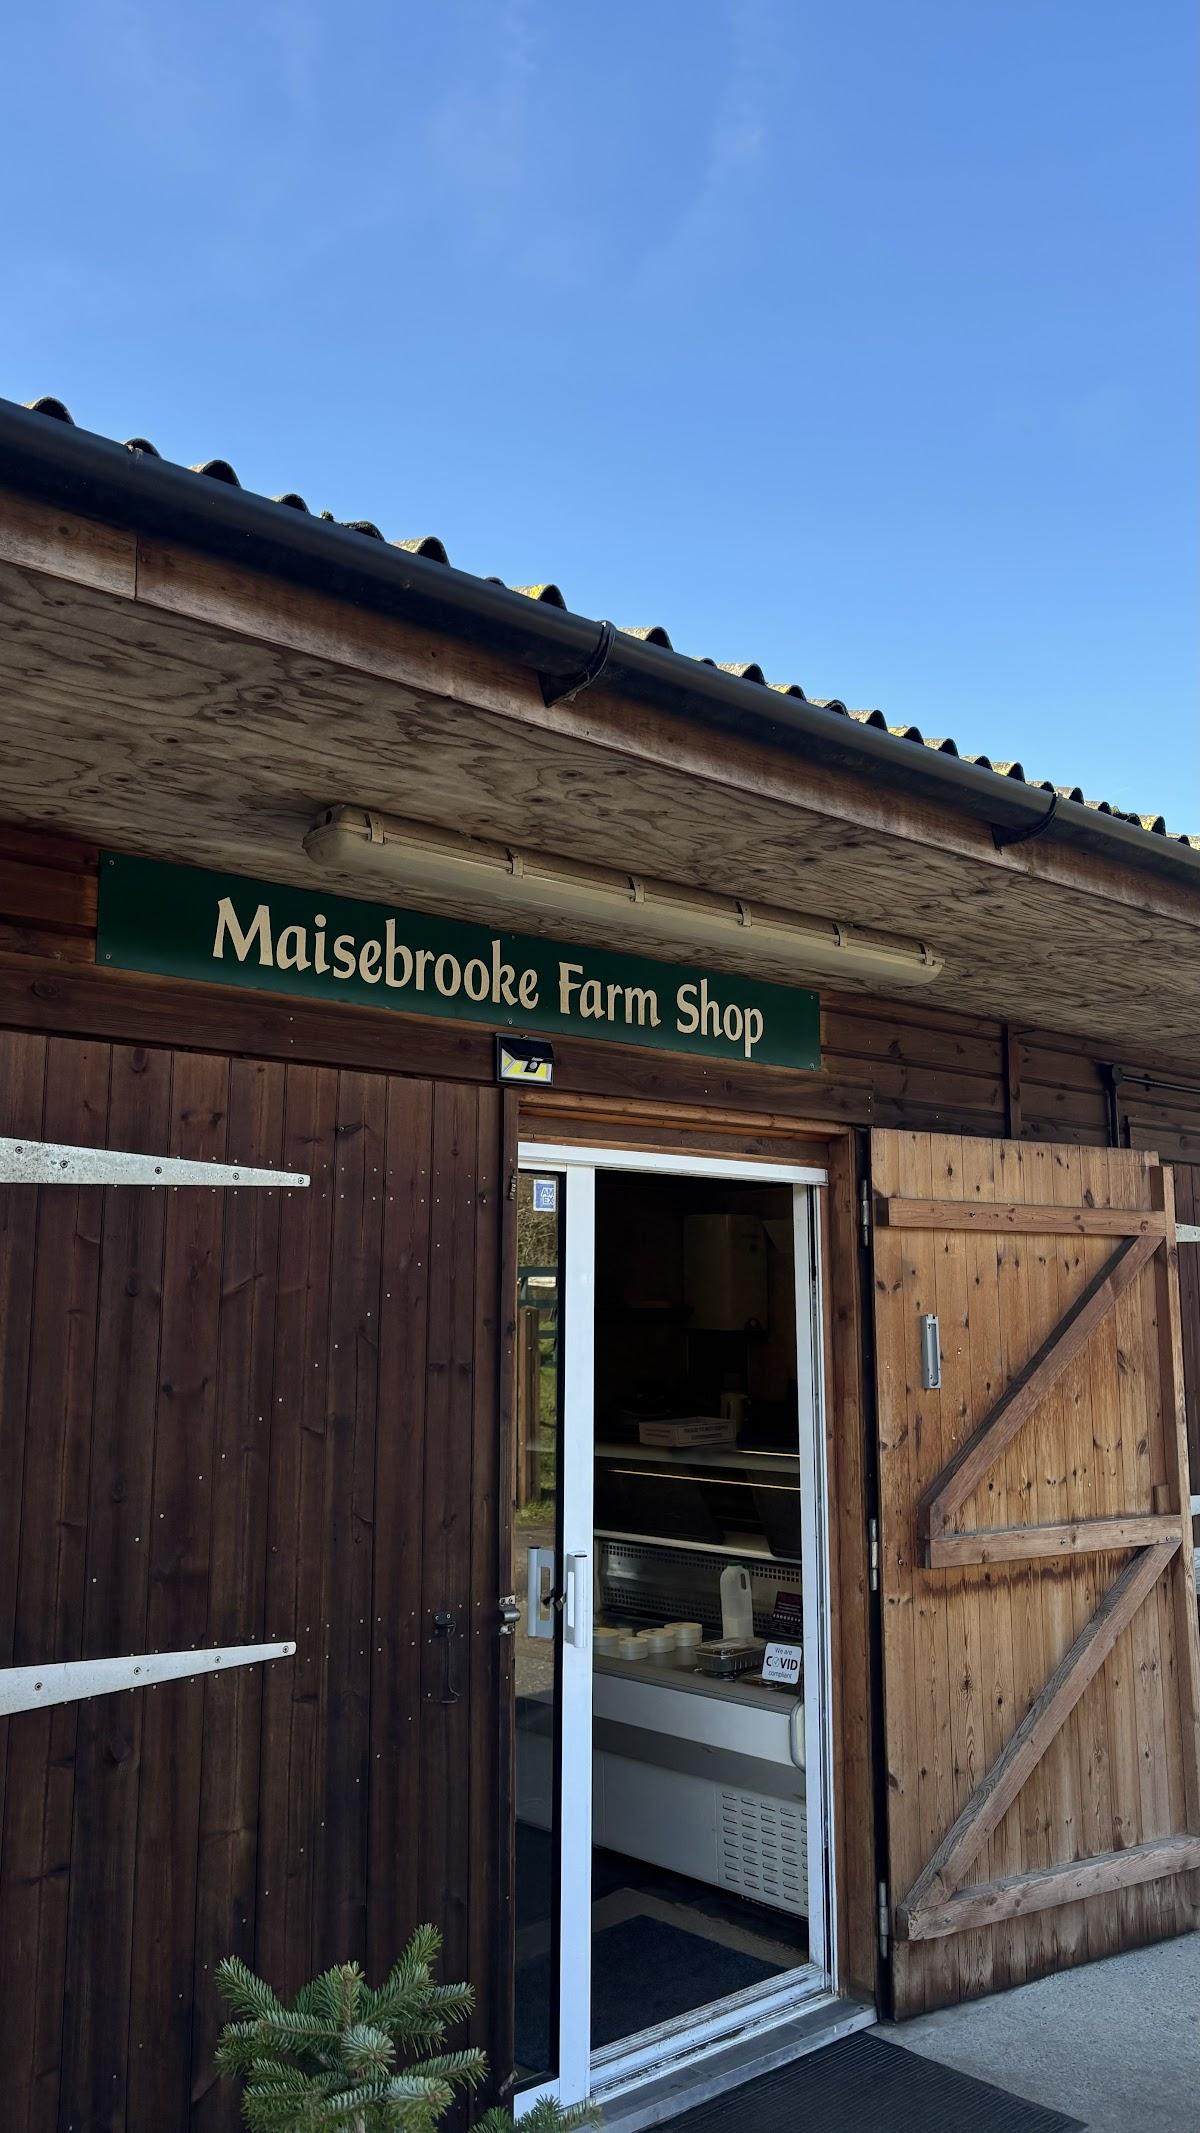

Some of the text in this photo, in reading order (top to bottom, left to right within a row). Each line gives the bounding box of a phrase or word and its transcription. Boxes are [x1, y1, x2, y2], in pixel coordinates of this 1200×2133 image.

[212, 896, 765, 1058] Maisebrooke Farm Shop
[775, 1647, 784, 1655] We
